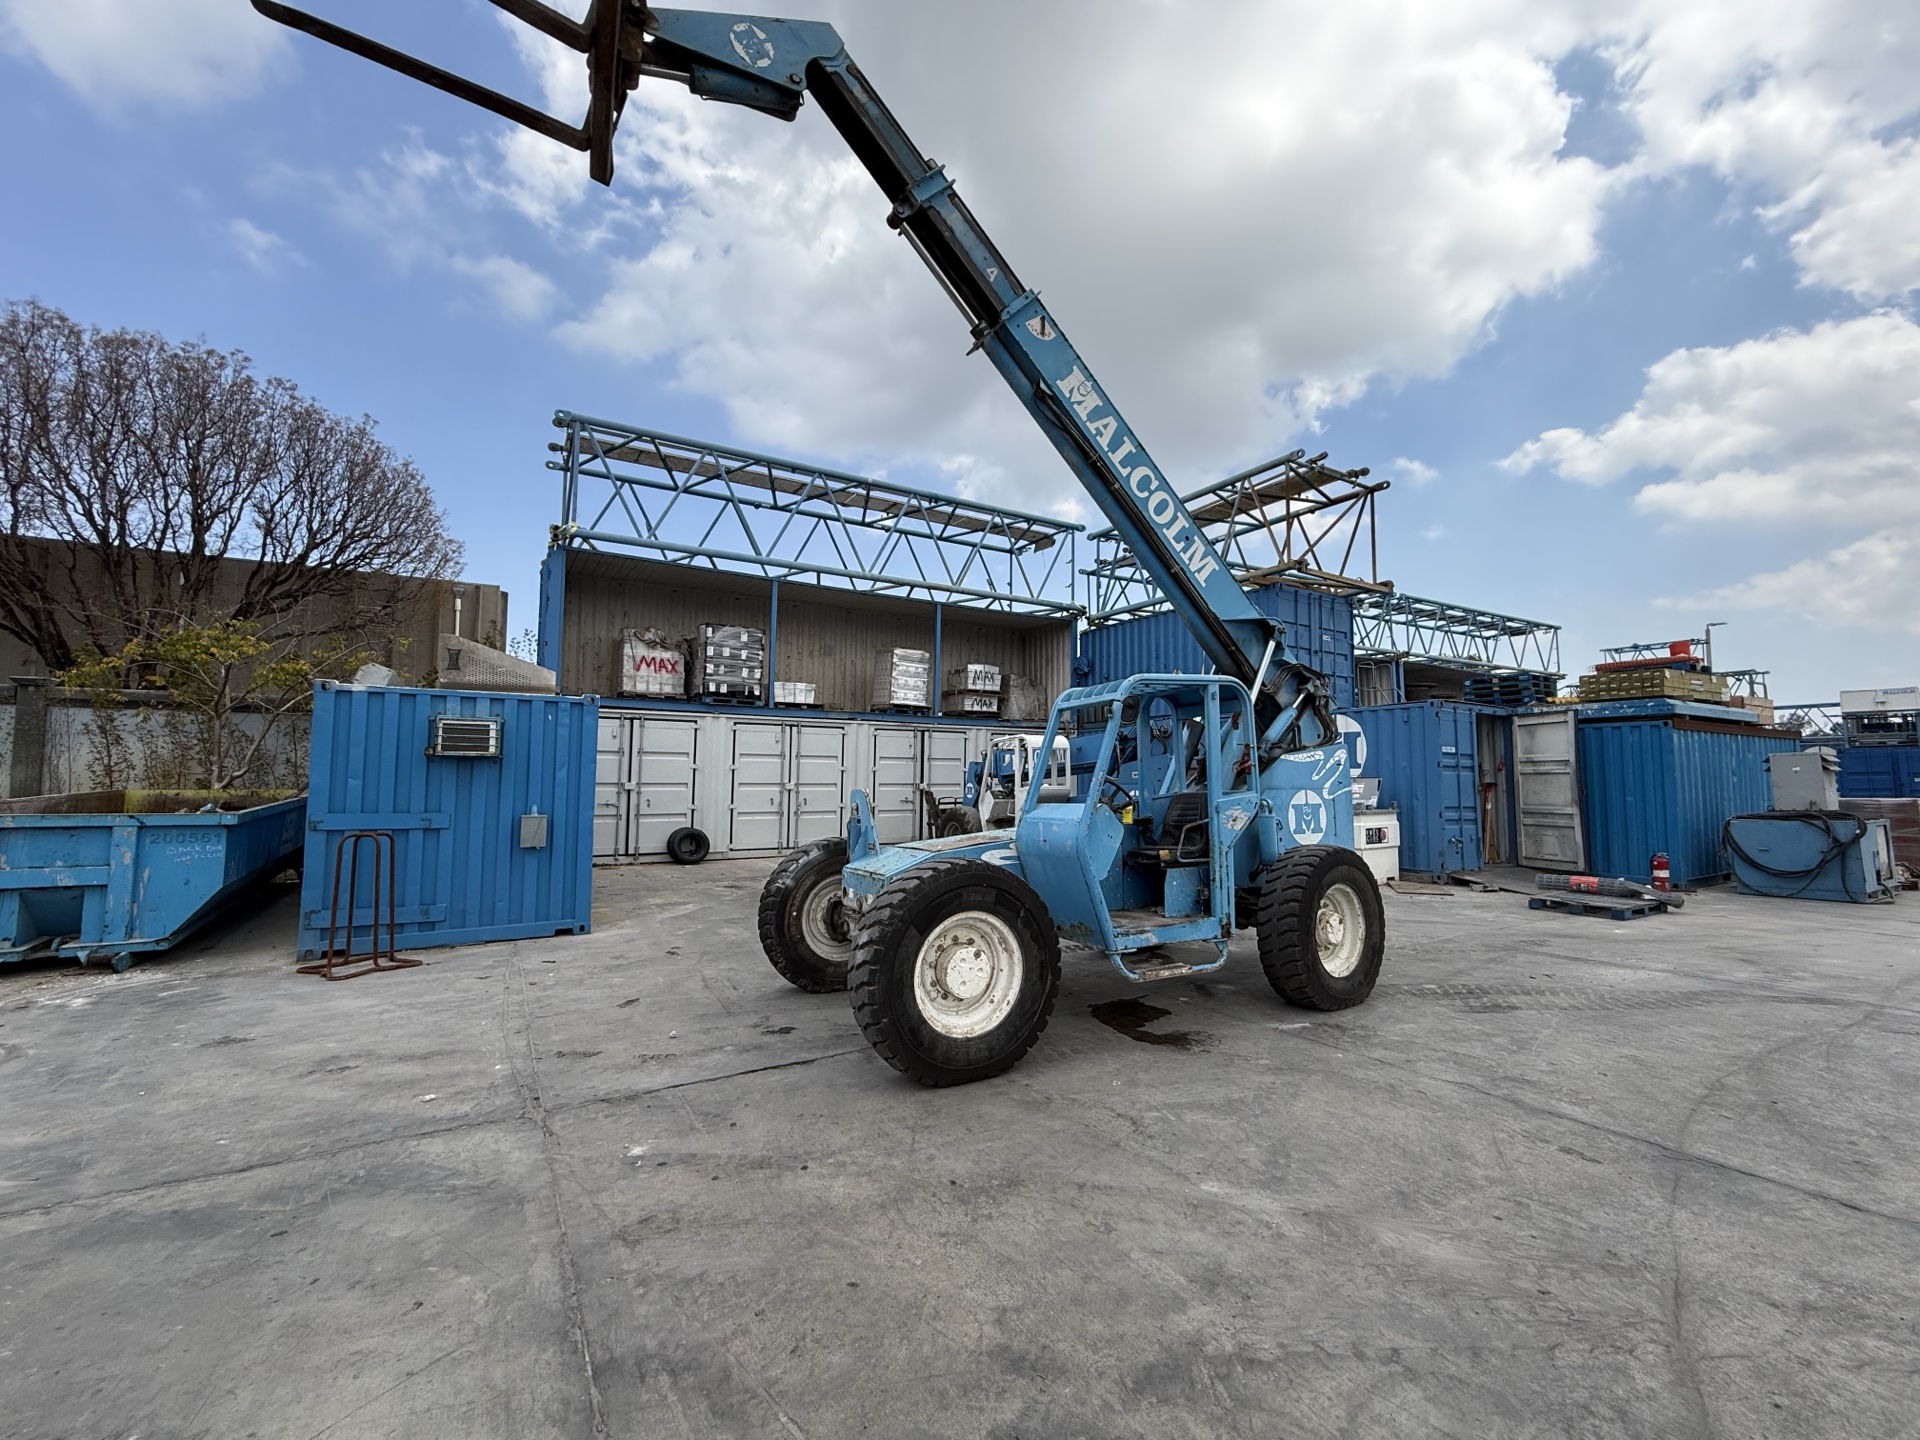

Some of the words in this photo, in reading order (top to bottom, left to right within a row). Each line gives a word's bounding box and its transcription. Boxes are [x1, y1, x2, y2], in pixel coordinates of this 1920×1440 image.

[1056, 365, 1220, 587] MALCOLM
[635, 655, 679, 675] MAX
[972, 669, 995, 687] MAX
[971, 697, 994, 710] MAX
[150, 832, 222, 845] 200561
